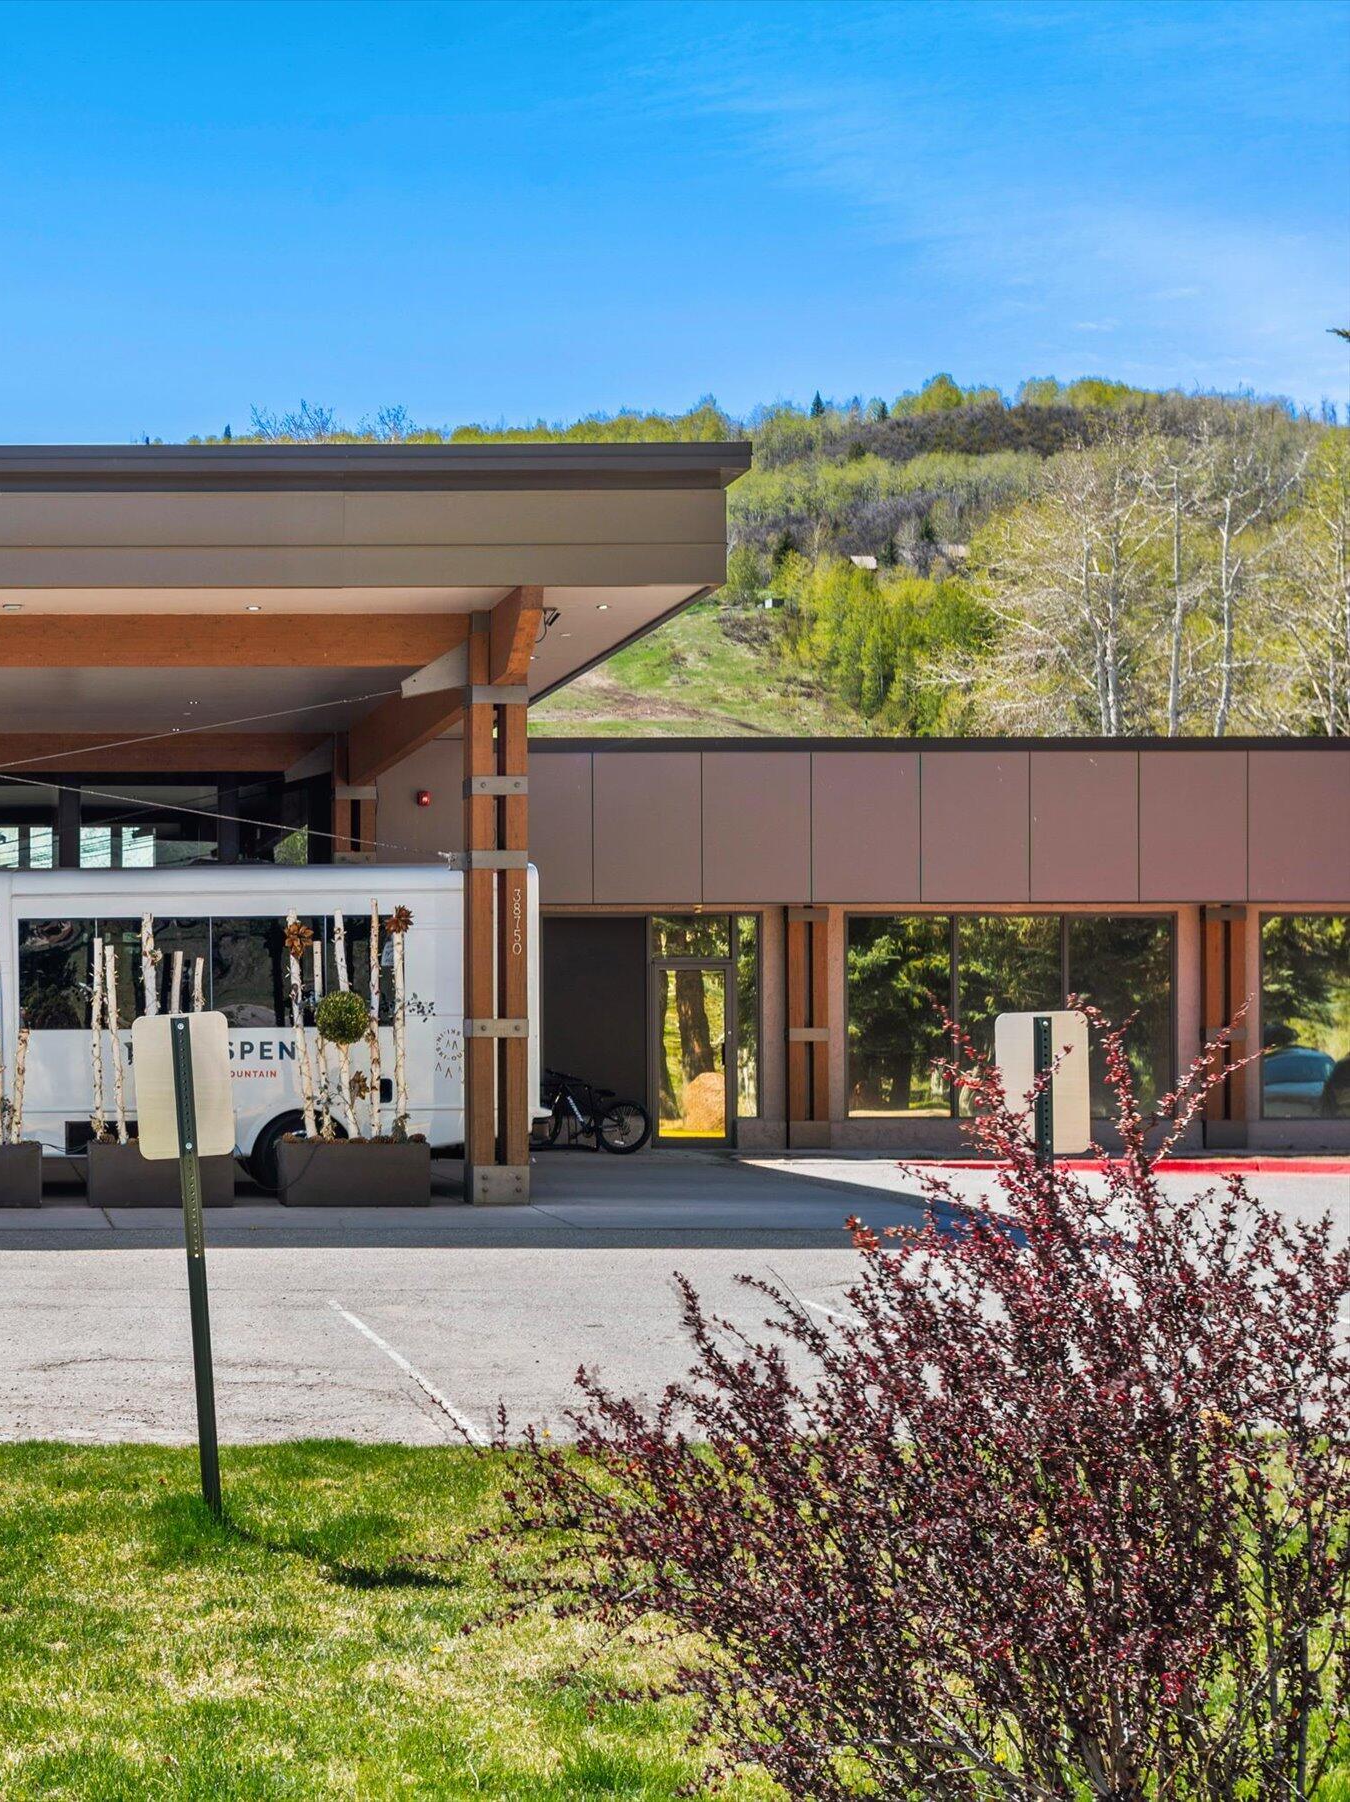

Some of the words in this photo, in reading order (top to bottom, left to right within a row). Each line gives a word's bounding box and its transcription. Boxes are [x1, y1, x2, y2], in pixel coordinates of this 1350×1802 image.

[512, 888, 522, 955] 38750
[228, 1041, 296, 1060] PEN
[230, 1070, 278, 1078] OUNTAIN
